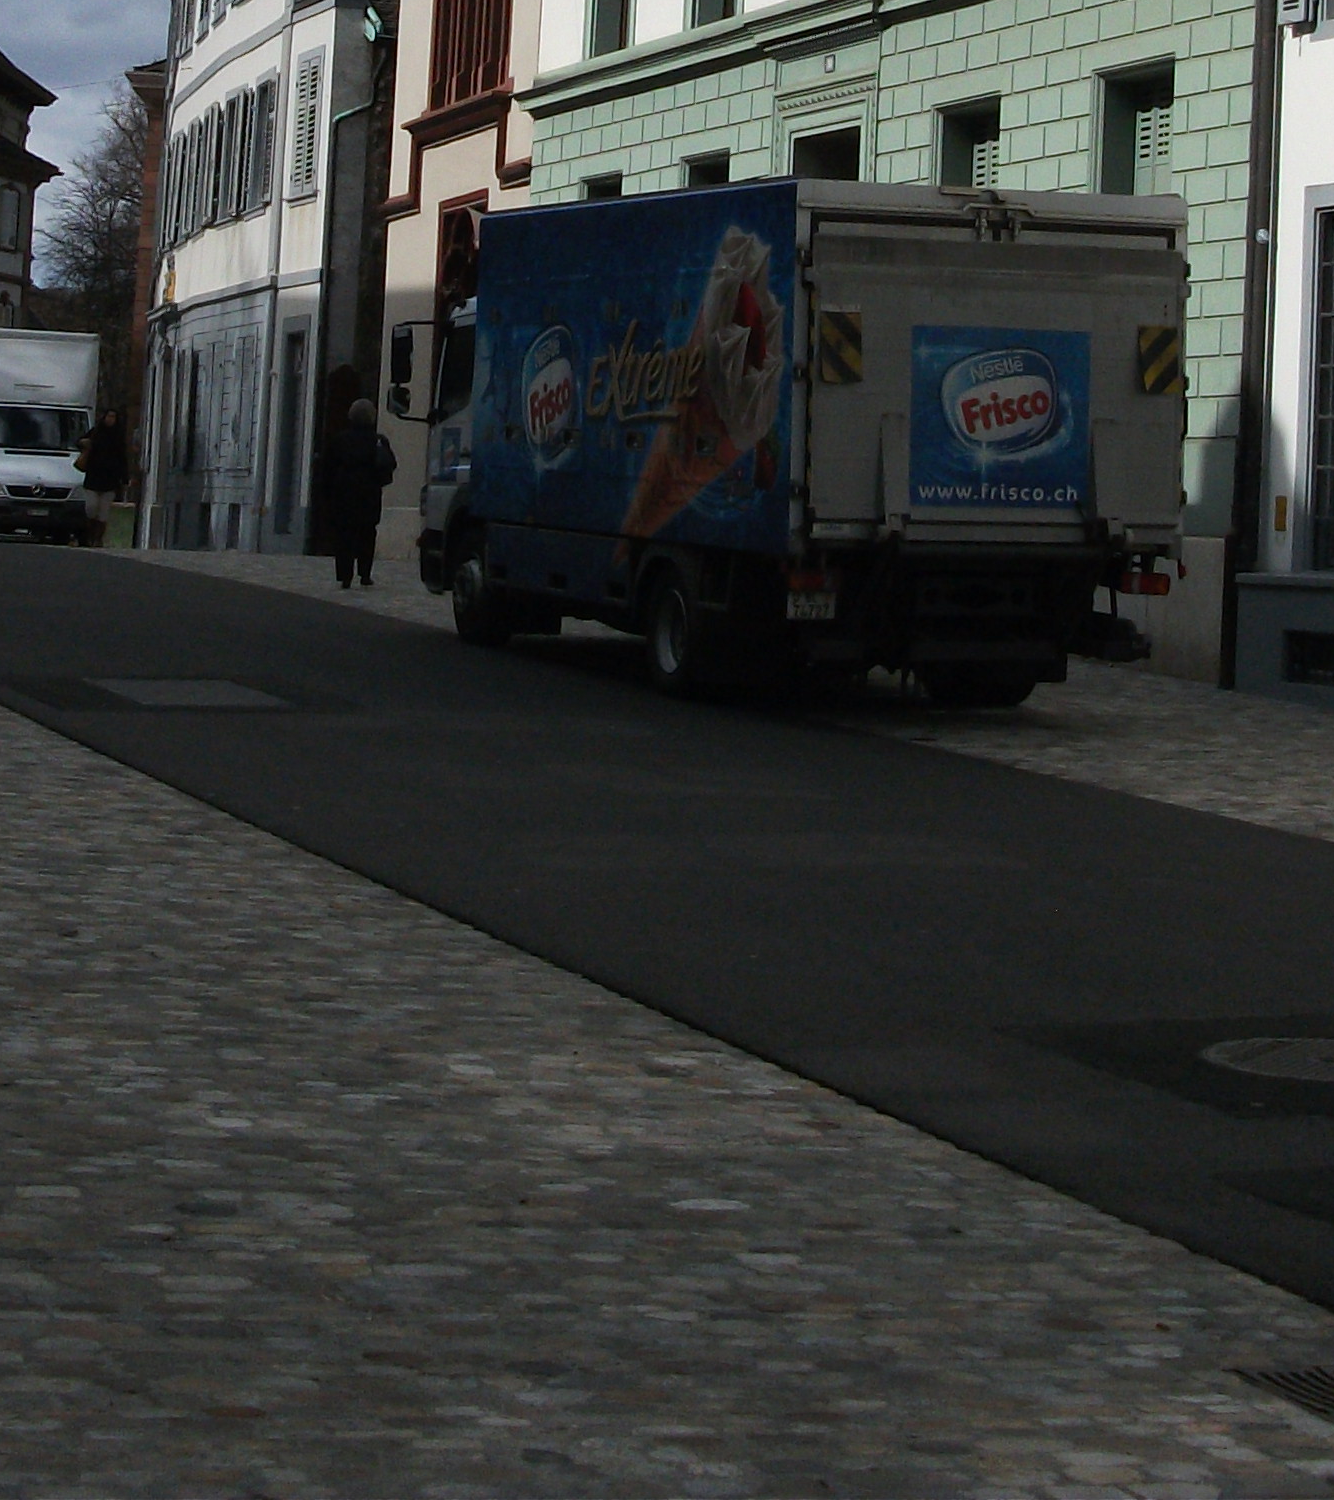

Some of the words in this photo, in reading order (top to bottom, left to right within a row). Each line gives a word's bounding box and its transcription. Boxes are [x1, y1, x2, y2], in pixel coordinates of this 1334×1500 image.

[970, 355, 1025, 384] Nestlé
[528, 376, 571, 438] Frisco
[959, 389, 1050, 435] Frisco
[918, 482, 1079, 503] www.frisco.ch
